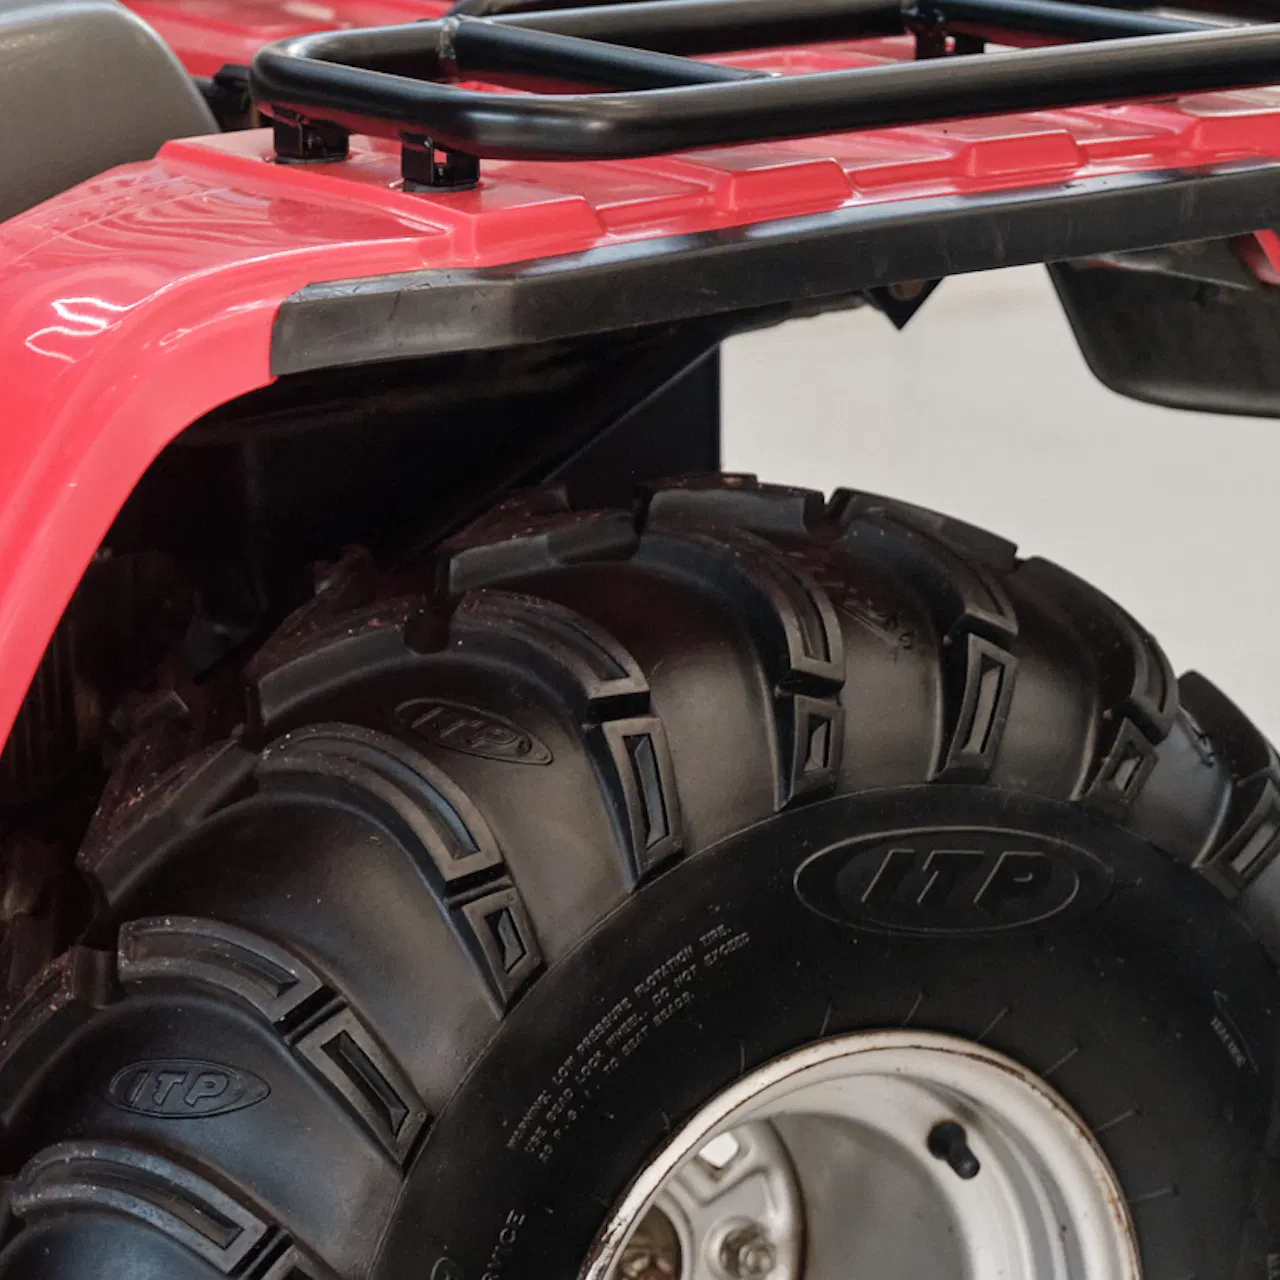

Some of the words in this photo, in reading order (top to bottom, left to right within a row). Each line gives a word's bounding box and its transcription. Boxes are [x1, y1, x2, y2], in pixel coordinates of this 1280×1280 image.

[859, 848, 1056, 914] ITP
[552, 1055, 577, 1085] LOW
[576, 996, 632, 1055] PRESSURE
[633, 944, 694, 998] FLOTATION
[574, 1050, 605, 1085] LOCK
[652, 986, 670, 1008] DO
[673, 963, 697, 988] NOT
[703, 931, 750, 967] EXCEED
[124, 1069, 230, 1107] ITP
